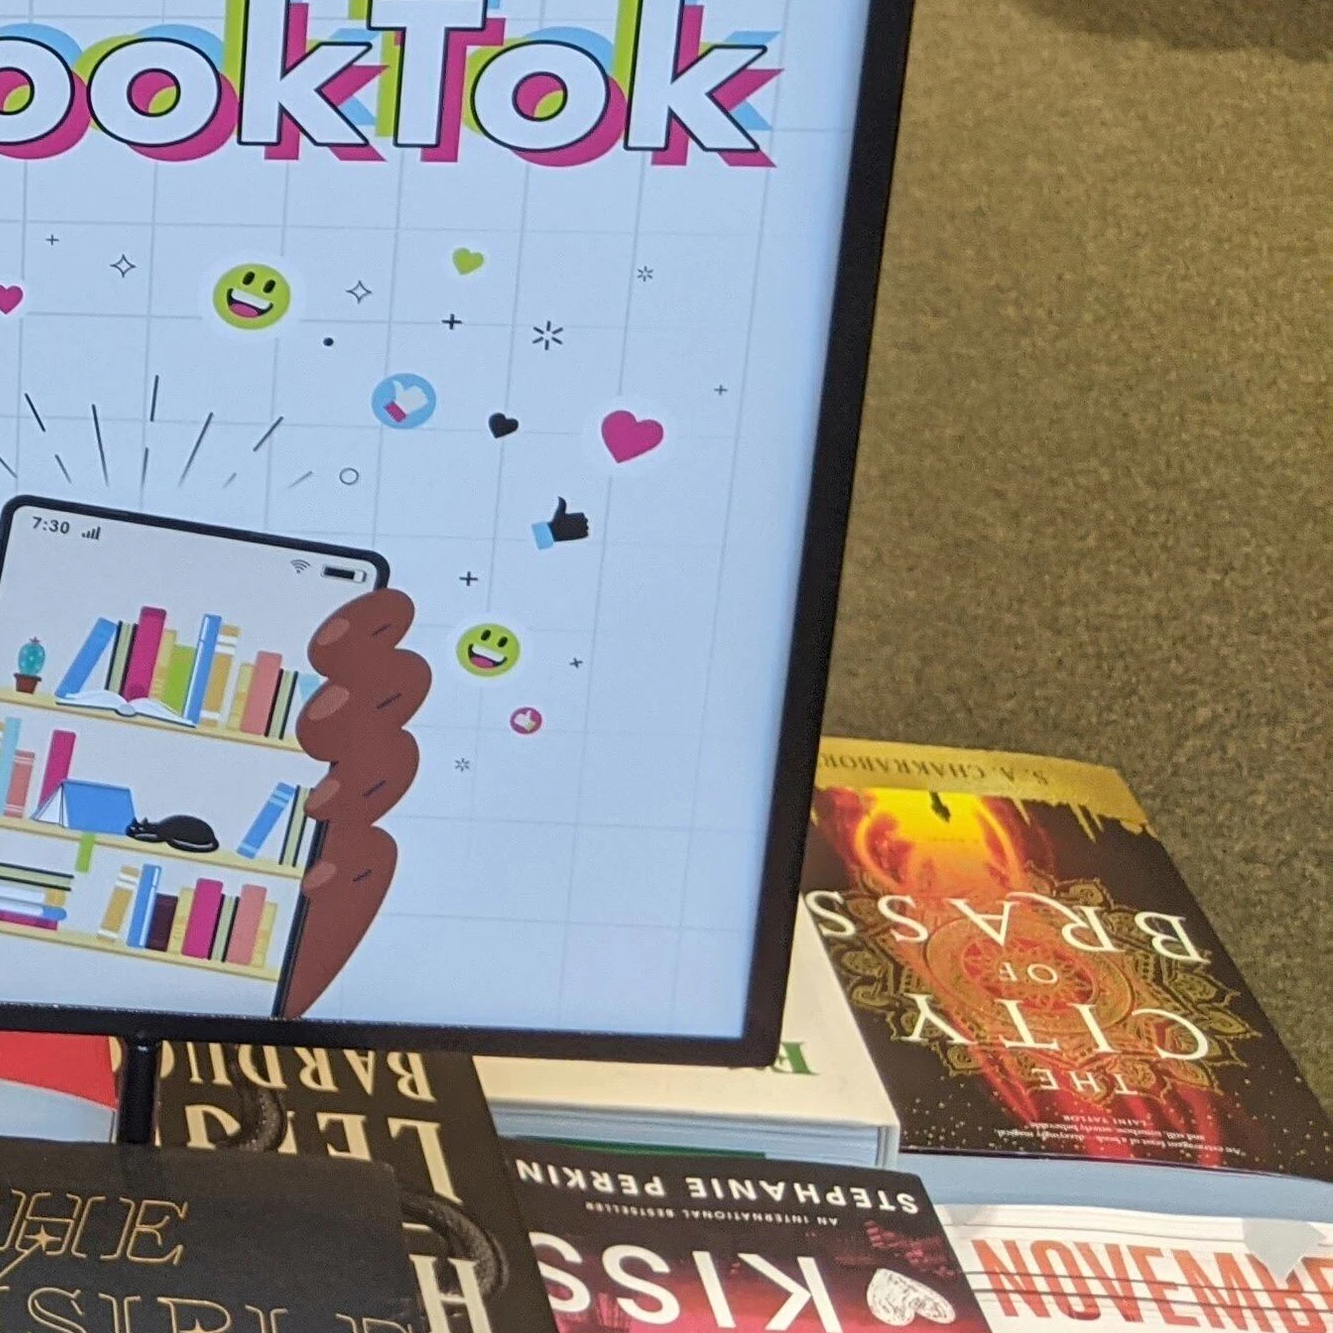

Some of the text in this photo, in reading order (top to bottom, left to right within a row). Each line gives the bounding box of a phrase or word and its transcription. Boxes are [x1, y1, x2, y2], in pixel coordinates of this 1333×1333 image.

[31, 515, 71, 535] 7:30
[819, 753, 986, 779] CHAKRABOR
[804, 889, 1211, 965] BRASS
[997, 960, 1059, 987] OF
[902, 992, 1210, 1062] CITY
[110, 1036, 436, 1102] BARDU
[1031, 1067, 1140, 1096] THE
[516, 1157, 921, 1216] STEPHANIE PERKIN
[584, 1200, 840, 1227] AN INTERNATIONAL BESTSELLER
[528, 1231, 841, 1333] KISS
